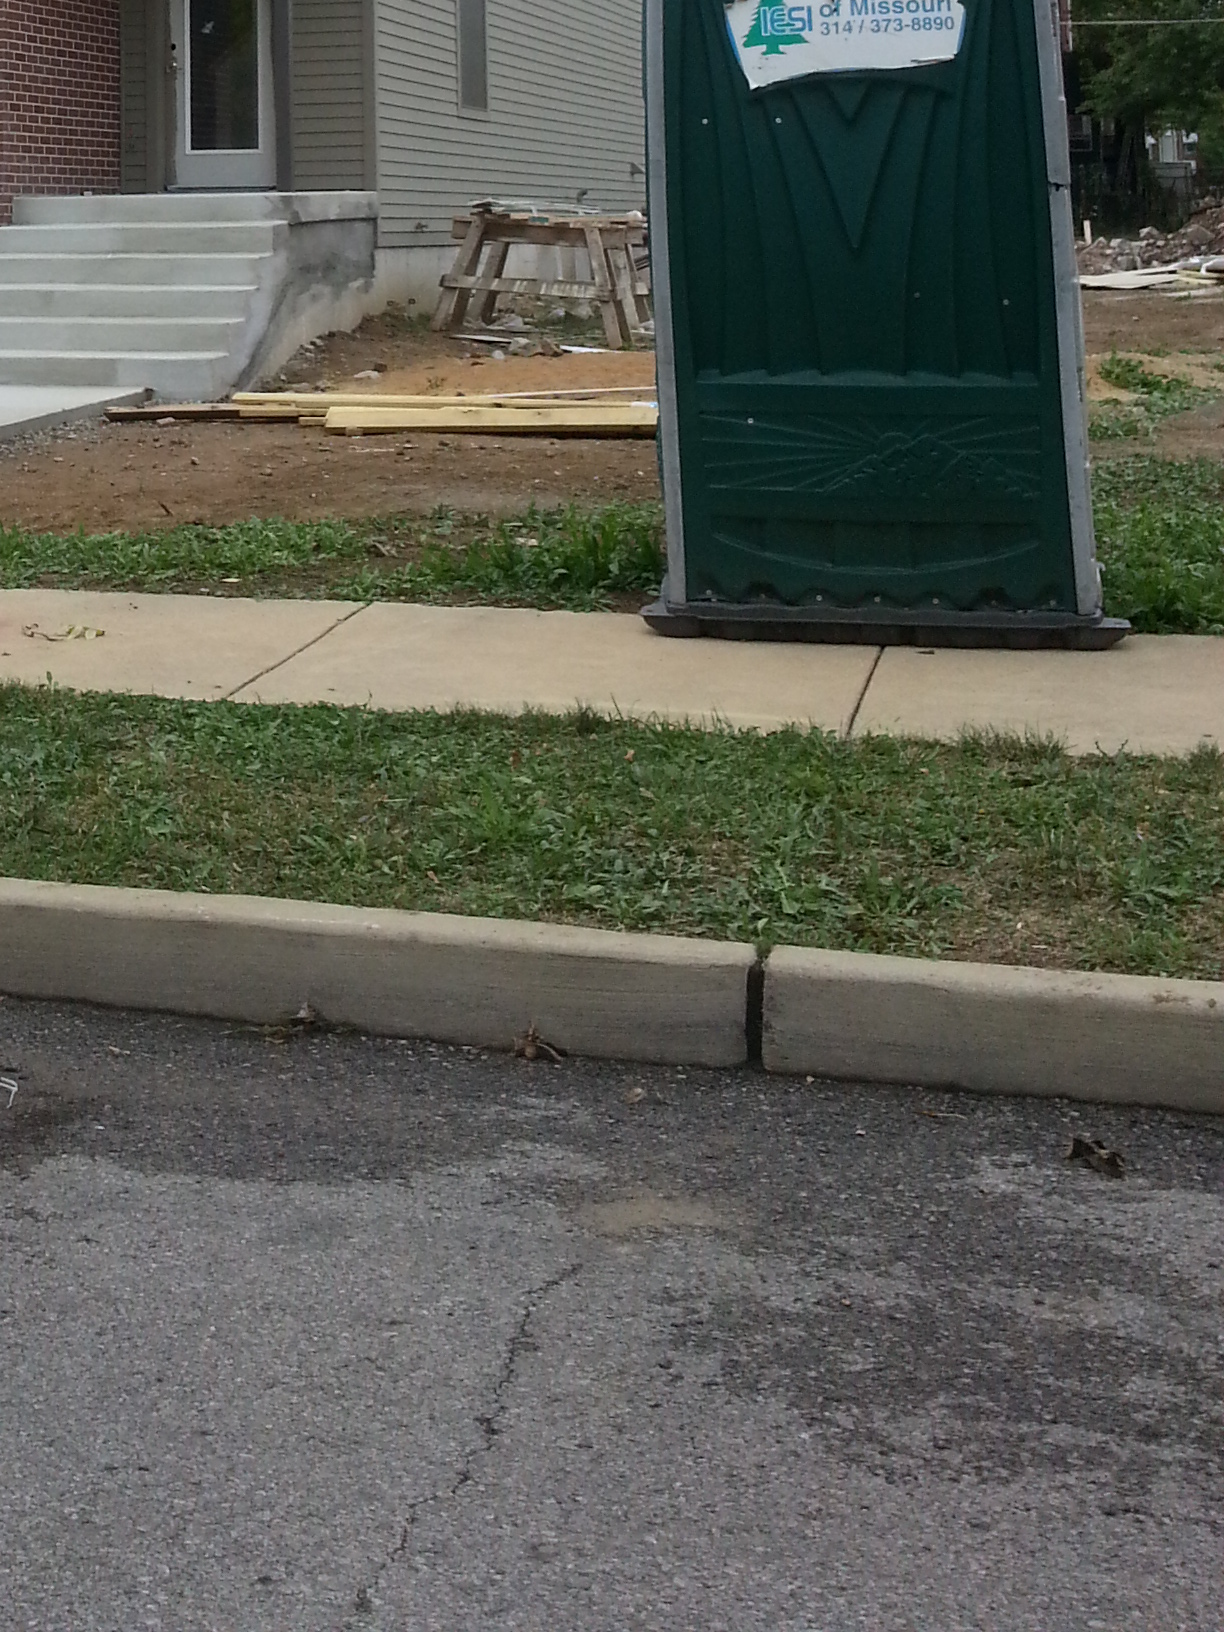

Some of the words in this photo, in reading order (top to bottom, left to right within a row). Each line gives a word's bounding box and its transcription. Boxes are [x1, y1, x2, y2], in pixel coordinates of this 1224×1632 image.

[760, 5, 813, 36] IESI
[819, 0, 841, 17] of
[820, 20, 853, 36] 314
[870, 16, 955, 33] 373-8890
